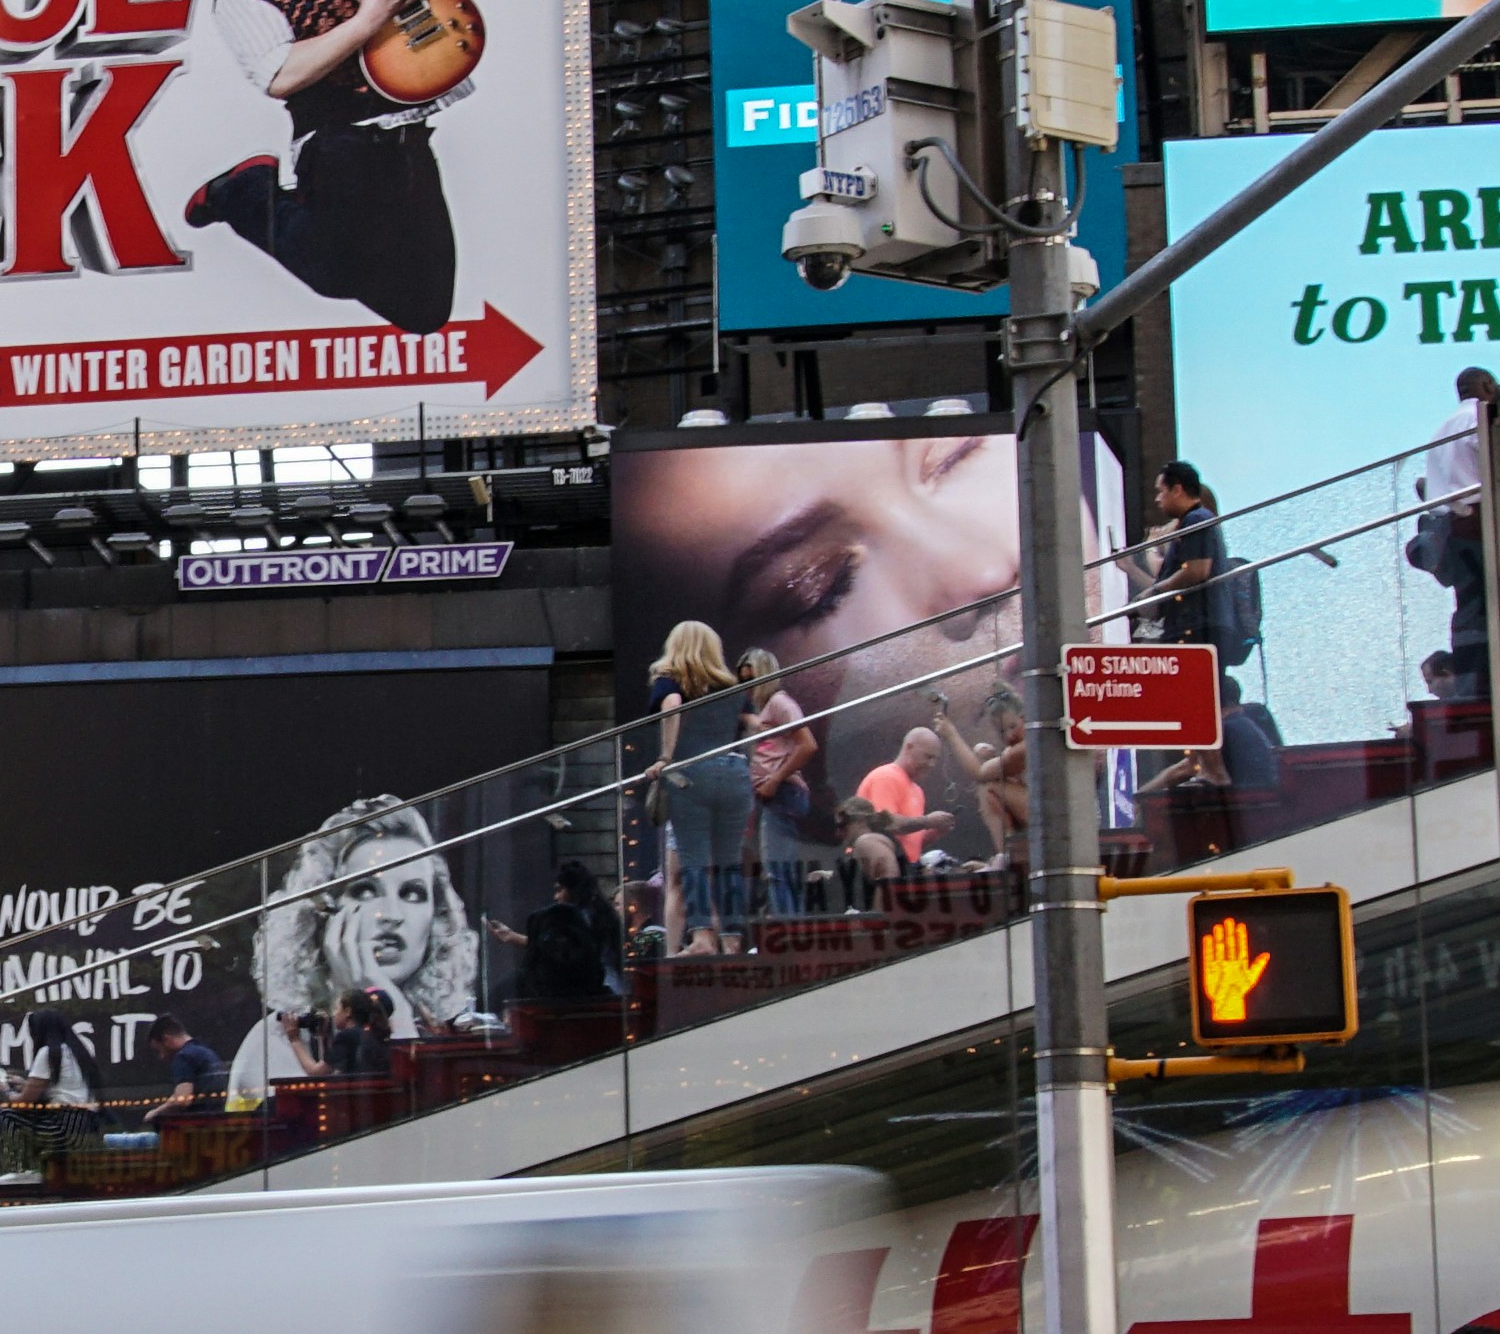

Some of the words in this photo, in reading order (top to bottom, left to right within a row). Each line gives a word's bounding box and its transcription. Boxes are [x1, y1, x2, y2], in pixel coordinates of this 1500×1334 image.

[822, 169, 866, 197] NYPD
[1290, 283, 1387, 348] to
[10, 346, 149, 395] WINTER
[157, 338, 302, 388] GARDEN
[312, 330, 468, 381] THEATRE
[187, 553, 379, 585] OUTFRONT
[399, 548, 499, 577] PRIME
[1071, 656, 1095, 674] NO
[1101, 656, 1179, 675] STANDING
[1074, 679, 1143, 701] Anytime
[132, 880, 206, 929] BE
[152, 942, 203, 994] TO
[110, 1013, 158, 1065] IT
